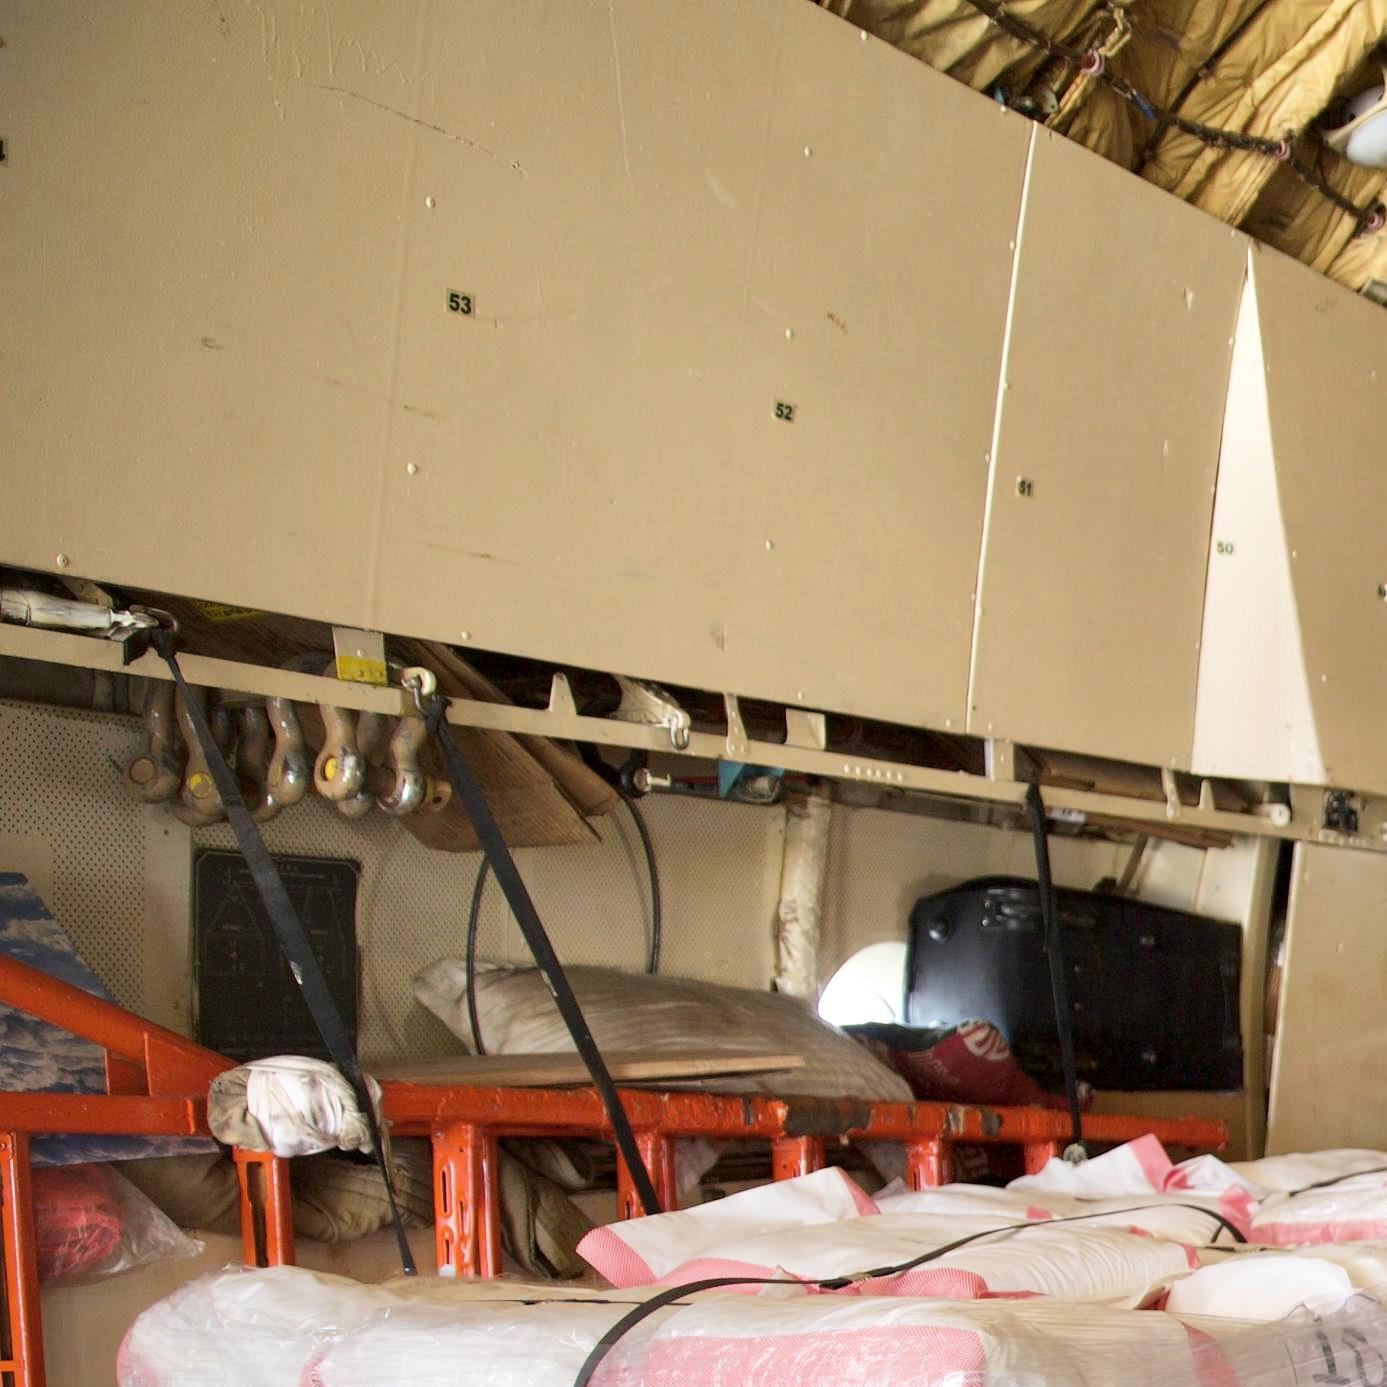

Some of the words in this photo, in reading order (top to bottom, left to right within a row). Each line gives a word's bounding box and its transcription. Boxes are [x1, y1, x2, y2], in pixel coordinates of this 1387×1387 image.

[449, 292, 472, 315] 53
[775, 402, 793, 421] 52
[1217, 541, 1234, 555] 50
